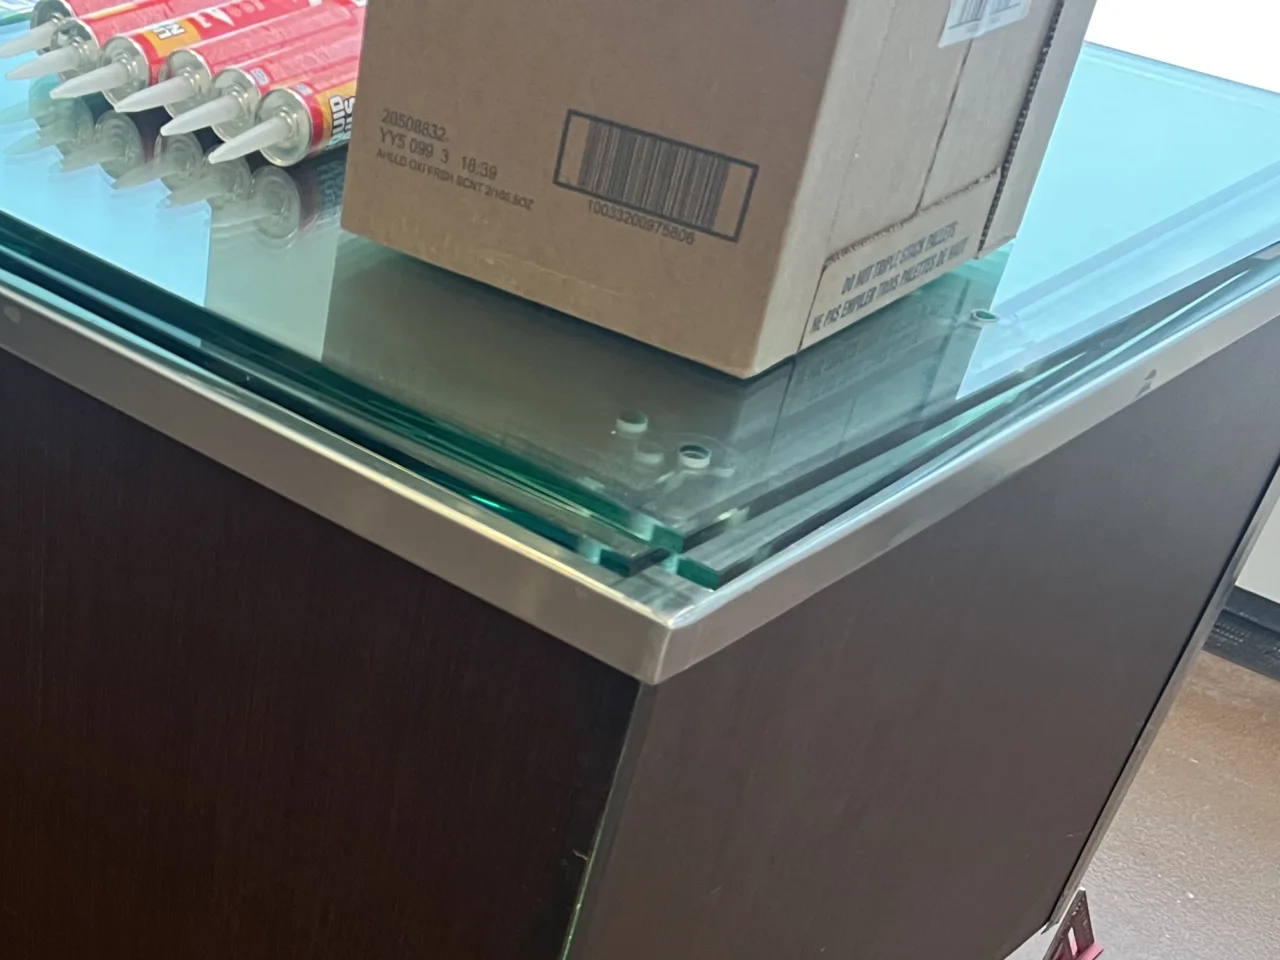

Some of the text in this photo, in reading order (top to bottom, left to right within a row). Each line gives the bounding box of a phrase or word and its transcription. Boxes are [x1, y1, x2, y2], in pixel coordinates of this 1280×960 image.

[381, 107, 449, 143] 20508832
[379, 126, 498, 180] YY5 099 3 18:39
[840, 273, 856, 295] DO
[854, 264, 875, 289] NOT
[872, 249, 902, 279] TRIPLE
[899, 236, 927, 264] STACK
[823, 303, 842, 328] PAS
